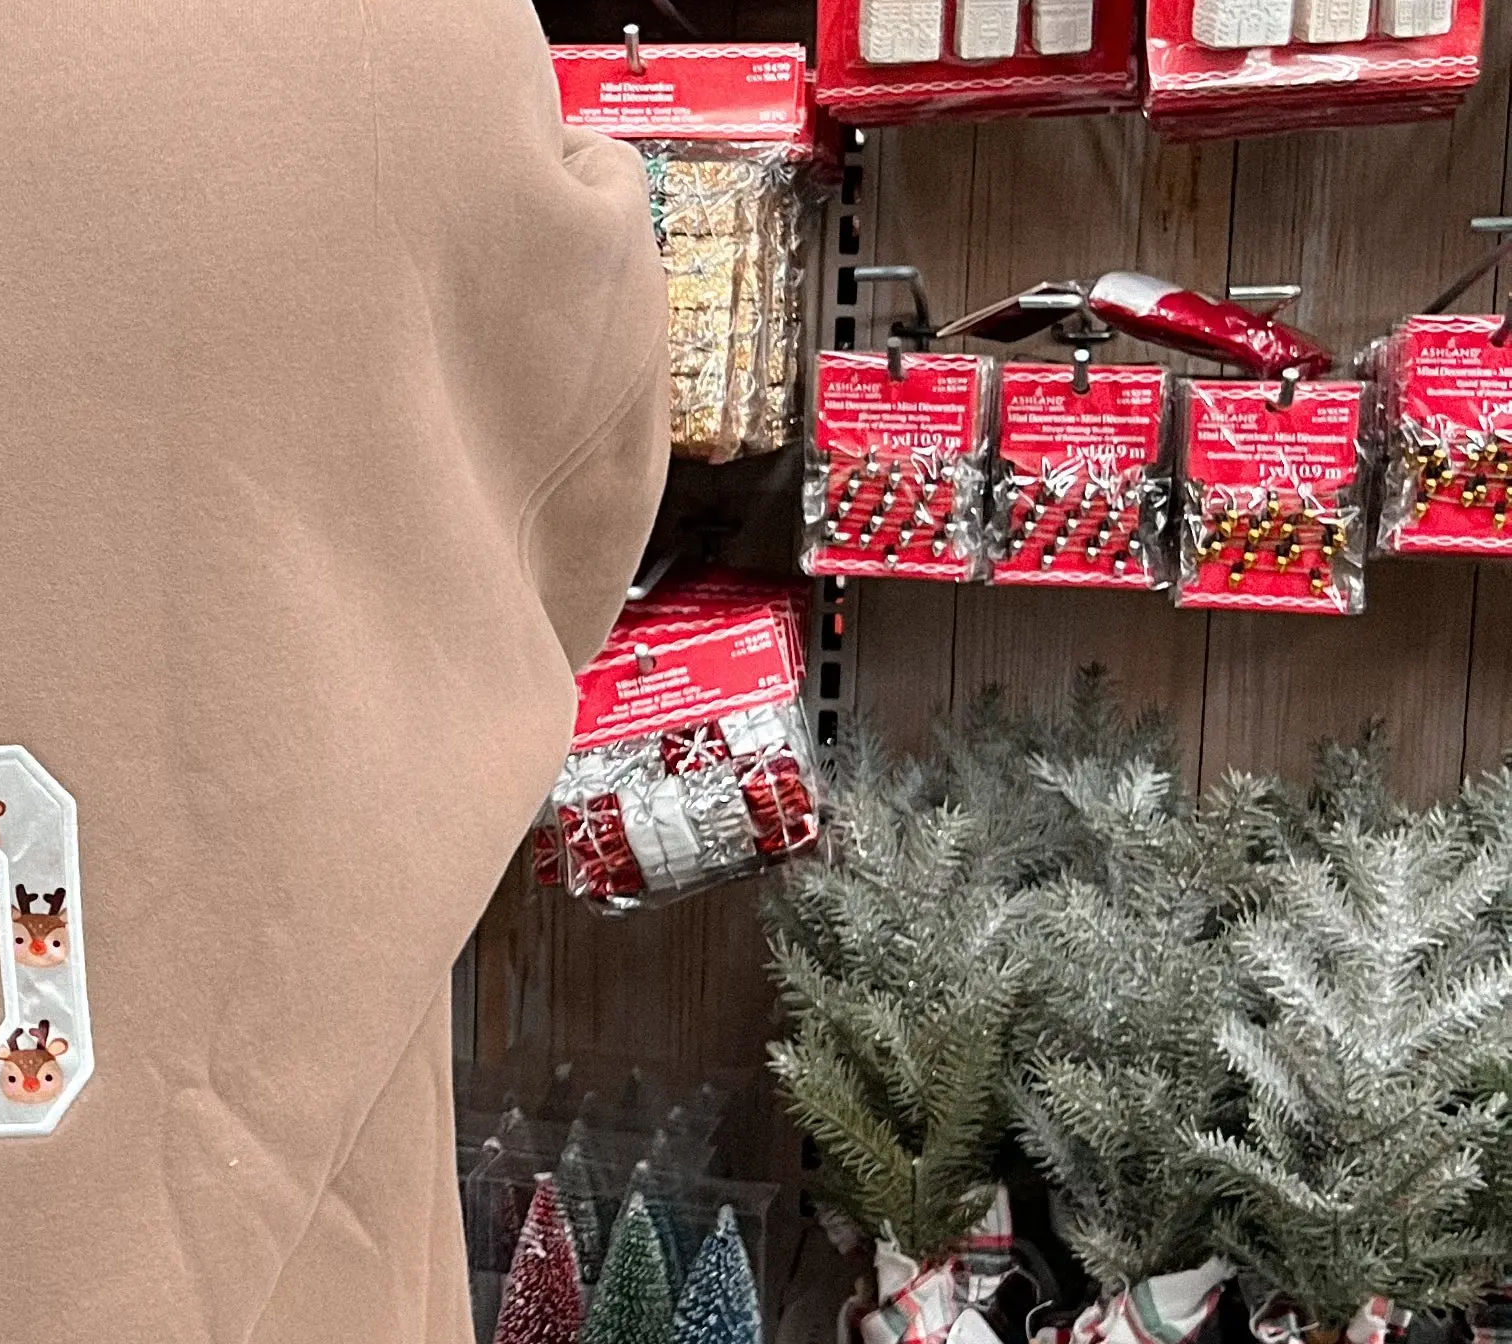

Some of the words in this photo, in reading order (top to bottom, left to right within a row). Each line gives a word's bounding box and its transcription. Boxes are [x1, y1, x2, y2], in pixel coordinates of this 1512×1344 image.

[600, 83, 623, 93] Mini
[623, 83, 674, 93] Decoration
[600, 93, 623, 102] Mini
[1420, 347, 1481, 358] ASHLAND
[1416, 366, 1439, 376] Mini
[1439, 367, 1492, 377] Decoration
[827, 382, 880, 393] ASHLAND
[824, 400, 844, 410] Mini
[845, 401, 891, 411] Decoration
[897, 402, 917, 411] Mini
[1010, 395, 1064, 405] ASHLAND
[1007, 413, 1028, 423] Mini
[1028, 413, 1075, 424] Decoration
[1080, 414, 1101, 424] Mini
[1202, 413, 1256, 423] ASHLAND
[891, 432, 910, 449] yd
[1197, 431, 1219, 441] Mini
[1274, 432, 1296, 442] Mini
[1129, 447, 1145, 459] m
[1299, 464, 1322, 478] 0.9
[1325, 467, 1341, 480] m
